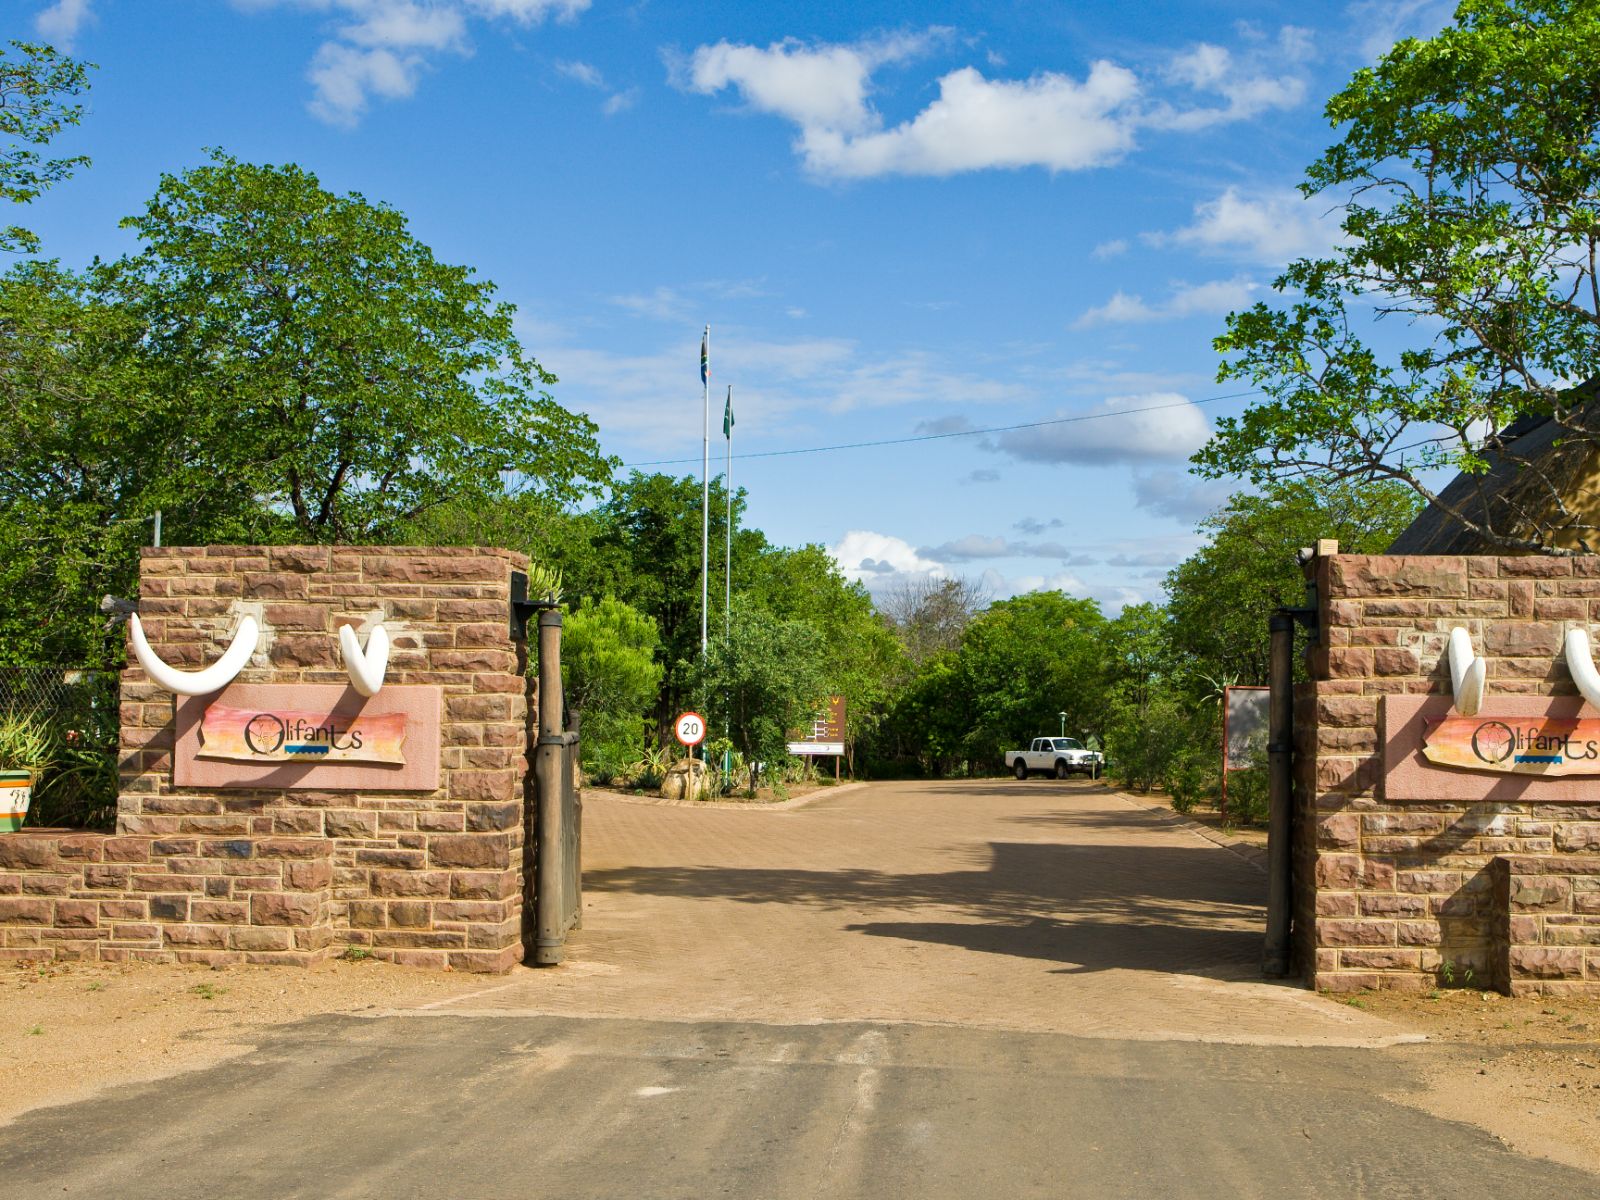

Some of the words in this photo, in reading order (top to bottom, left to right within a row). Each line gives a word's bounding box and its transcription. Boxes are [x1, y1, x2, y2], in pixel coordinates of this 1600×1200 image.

[244, 713, 363, 755] Olifants
[683, 722, 698, 735] 20
[1471, 721, 1598, 764] Olifants
